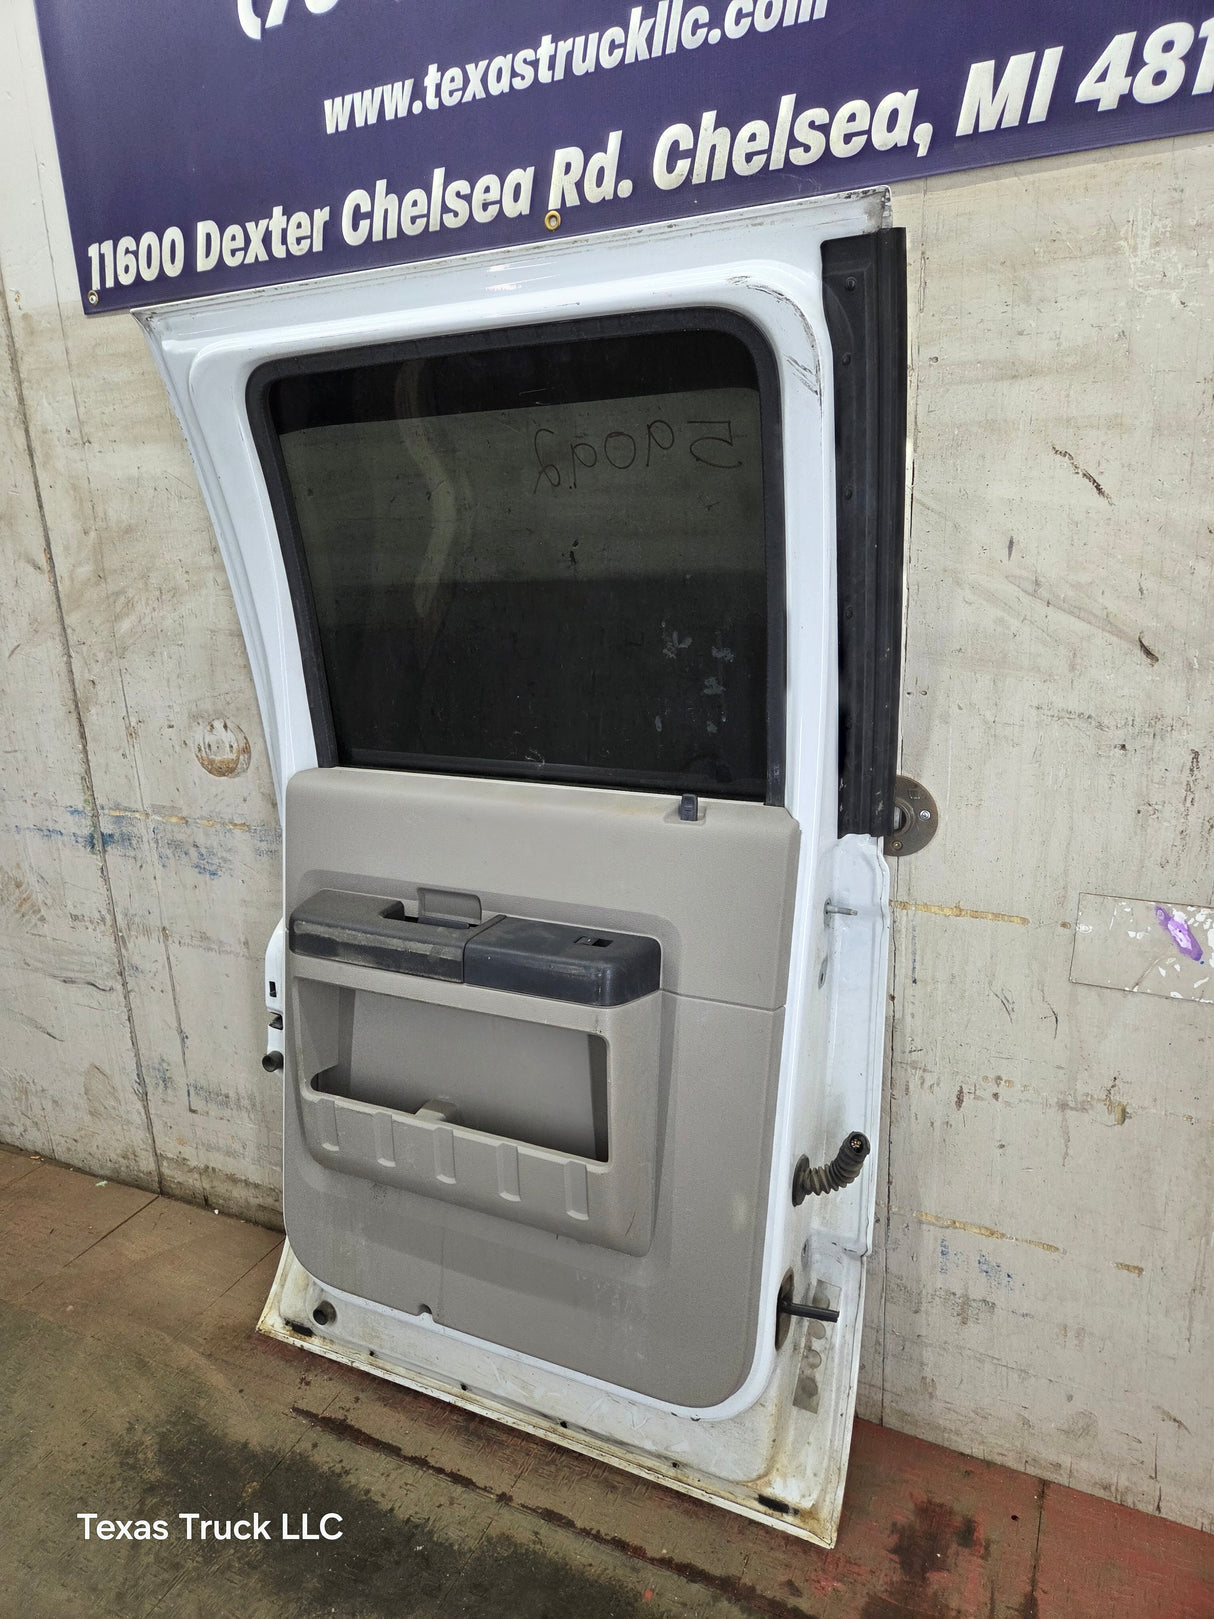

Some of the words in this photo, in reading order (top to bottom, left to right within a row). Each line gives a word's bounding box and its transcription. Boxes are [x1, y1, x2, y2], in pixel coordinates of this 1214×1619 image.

[87, 226, 185, 291] 11600
[196, 205, 330, 273] Dexter
[341, 165, 535, 246] Chelsea
[547, 129, 633, 211] Rd.
[652, 88, 933, 191] Chelsea,
[955, 45, 1064, 137] MI
